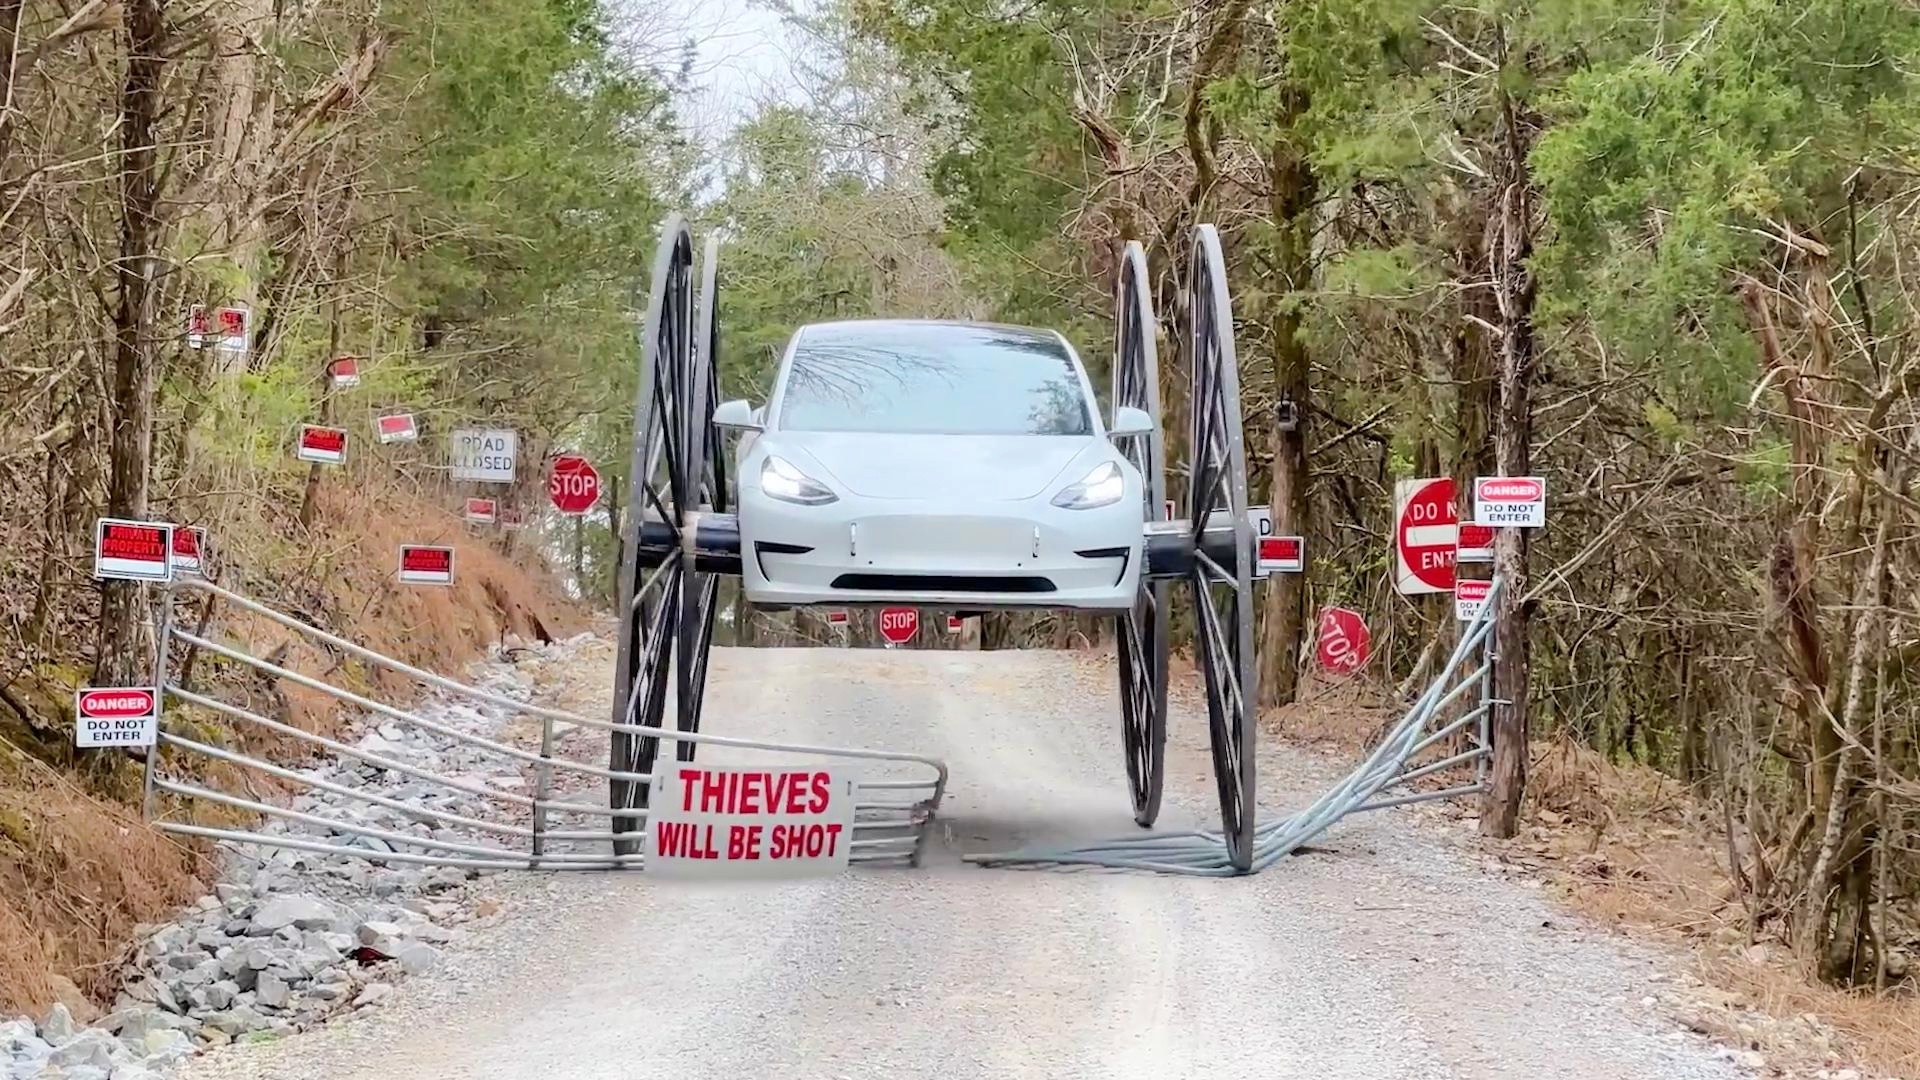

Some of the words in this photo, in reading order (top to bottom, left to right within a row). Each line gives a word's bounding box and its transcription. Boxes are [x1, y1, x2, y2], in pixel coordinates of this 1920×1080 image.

[551, 473, 596, 497] STOP
[1483, 485, 1537, 497] DANGER
[1413, 502, 1438, 521] DO
[1484, 504, 1503, 512] DO
[1507, 504, 1536, 512] NOT
[1489, 513, 1531, 522] ENTER
[109, 526, 159, 542] PRIVATE
[103, 539, 165, 556] PROPERTY
[1422, 550, 1456, 570] ENT
[1460, 586, 1487, 596] DANG
[883, 612, 915, 630] STOP
[86, 697, 148, 711] DANGER
[87, 721, 110, 730] DO
[115, 720, 146, 729] NOT
[93, 731, 140, 741] ENTER
[679, 769, 831, 815] THIEVES
[658, 821, 719, 860] WILL
[727, 825, 763, 860] BE
[769, 823, 843, 860] SHOT
